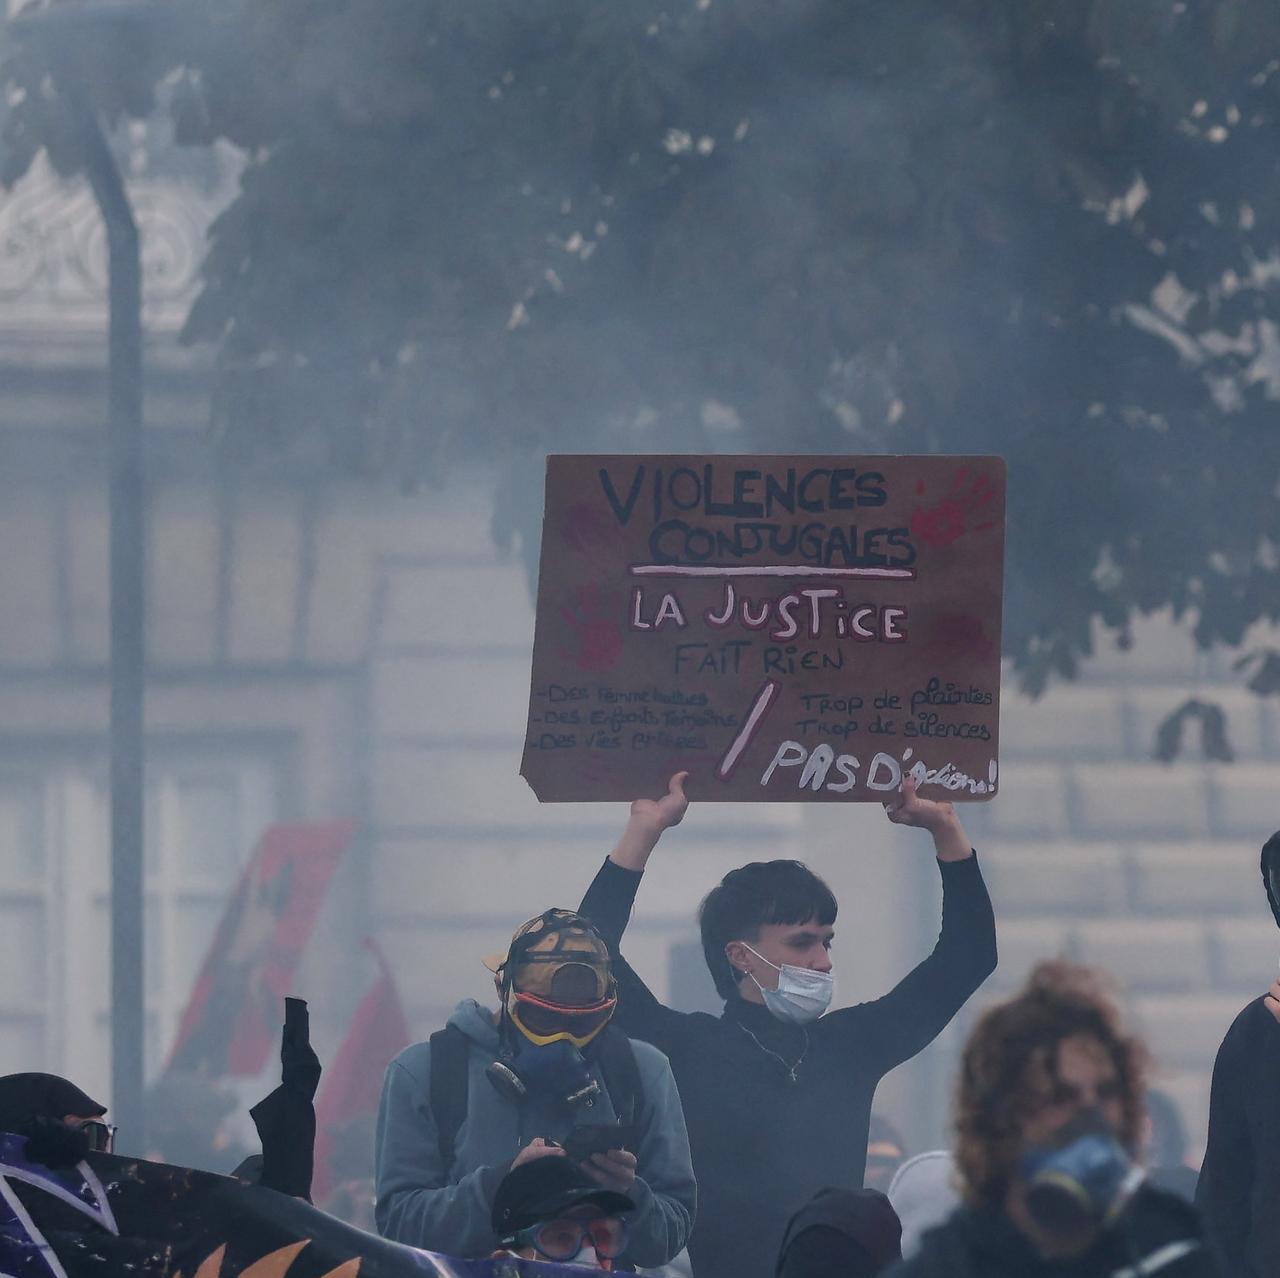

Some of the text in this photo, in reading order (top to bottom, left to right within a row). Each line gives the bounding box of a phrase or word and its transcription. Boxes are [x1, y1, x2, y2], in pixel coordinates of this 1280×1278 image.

[599, 464, 888, 525] VIOLENCES
[649, 518, 917, 567] CONJUGALES
[633, 588, 686, 629] LA
[760, 740, 861, 793] PAS
